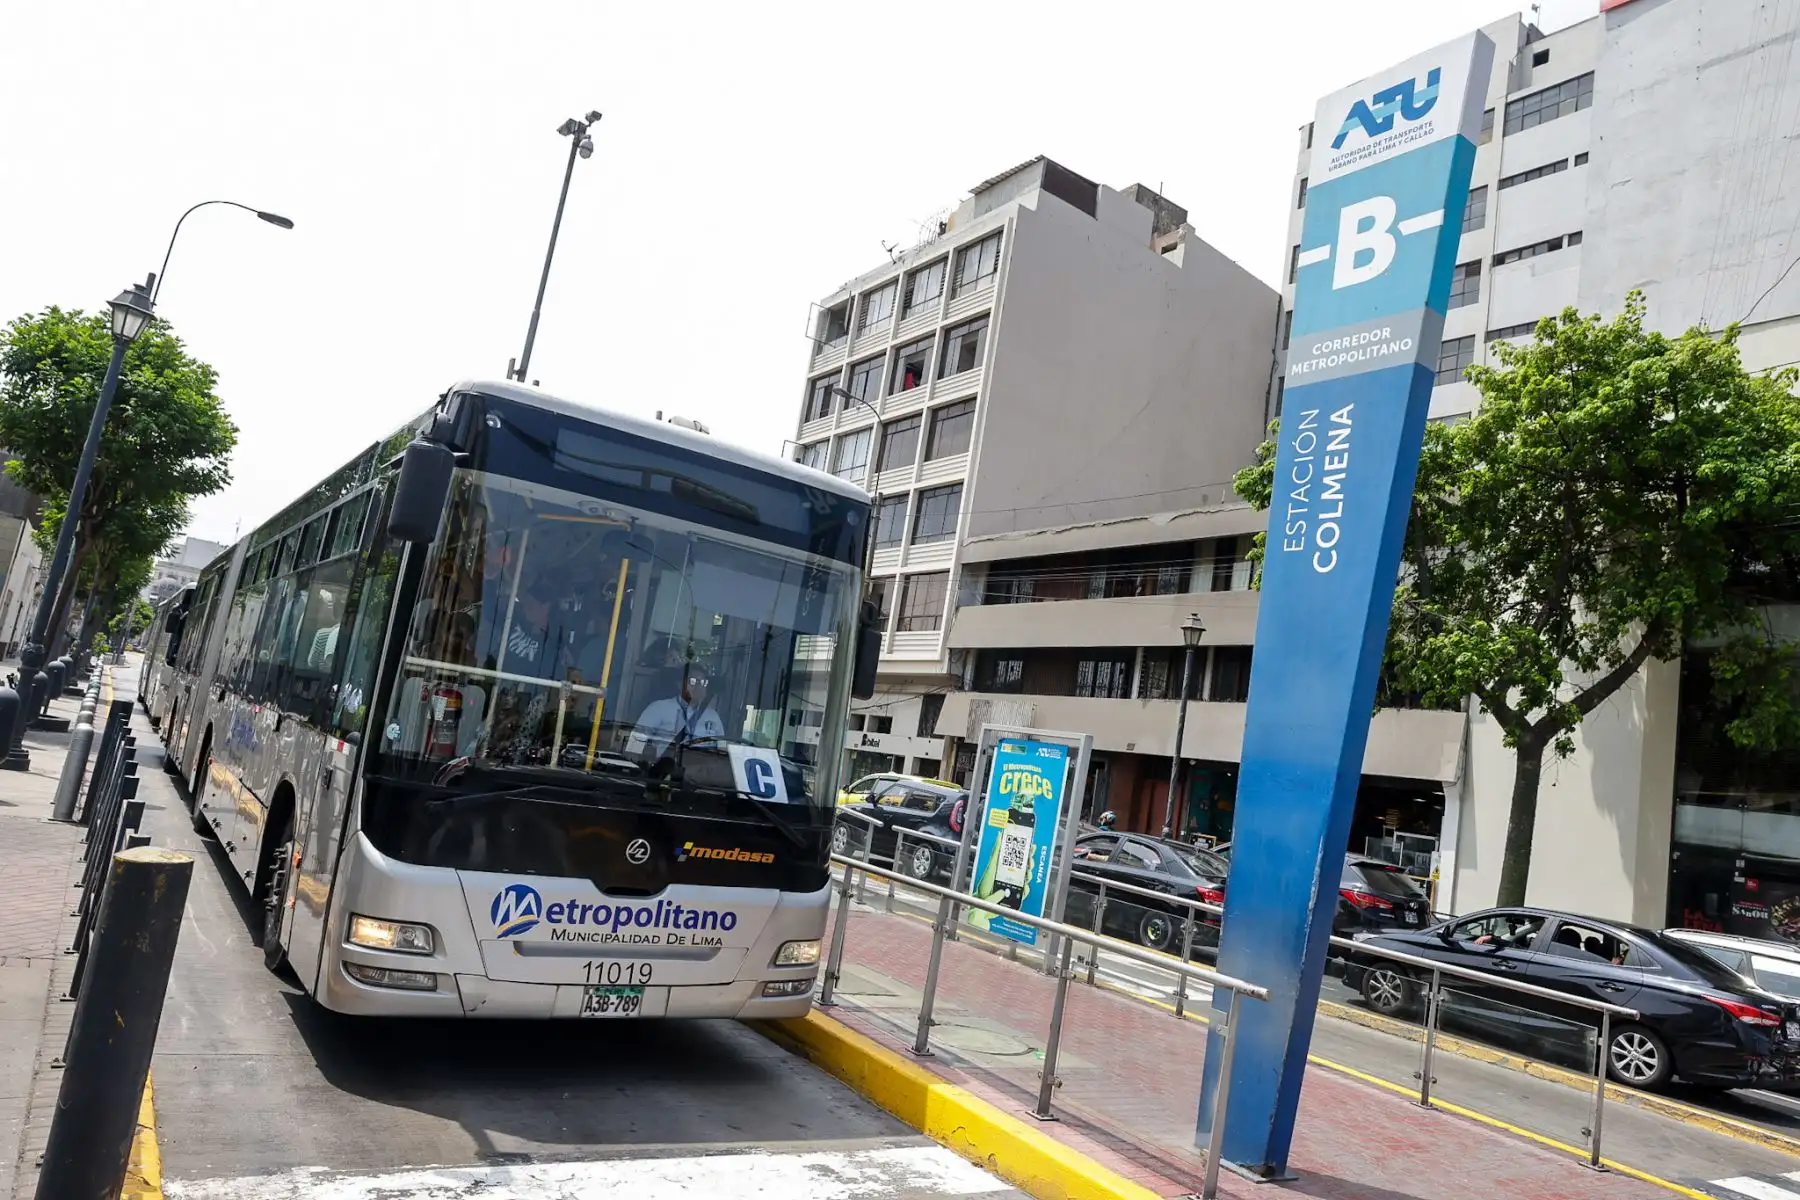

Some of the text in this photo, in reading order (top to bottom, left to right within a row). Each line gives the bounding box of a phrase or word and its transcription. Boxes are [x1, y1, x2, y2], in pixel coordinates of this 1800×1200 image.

[1331, 66, 1441, 150] ATU
[1328, 157, 1358, 173] URBANO
[1358, 150, 1378, 162] PARA
[1378, 142, 1397, 154] LIMA
[1404, 127, 1434, 144] CALLAO
[1331, 120, 1433, 164] AUTORIDAD DE TRANSPORTE
[1332, 195, 1397, 291] B
[1291, 337, 1412, 376] METROPOLITANO
[1312, 326, 1392, 356] CORREDOR
[1283, 408, 1320, 552] ESTACIÓN
[1312, 402, 1355, 574] COLMENA
[744, 758, 777, 800] C
[689, 846, 776, 864] modasa
[550, 928, 661, 945] MUNICIPALIDAD
[691, 934, 724, 947] LIMA
[582, 960, 653, 985] 11019
[584, 994, 640, 1013] A3B-789
